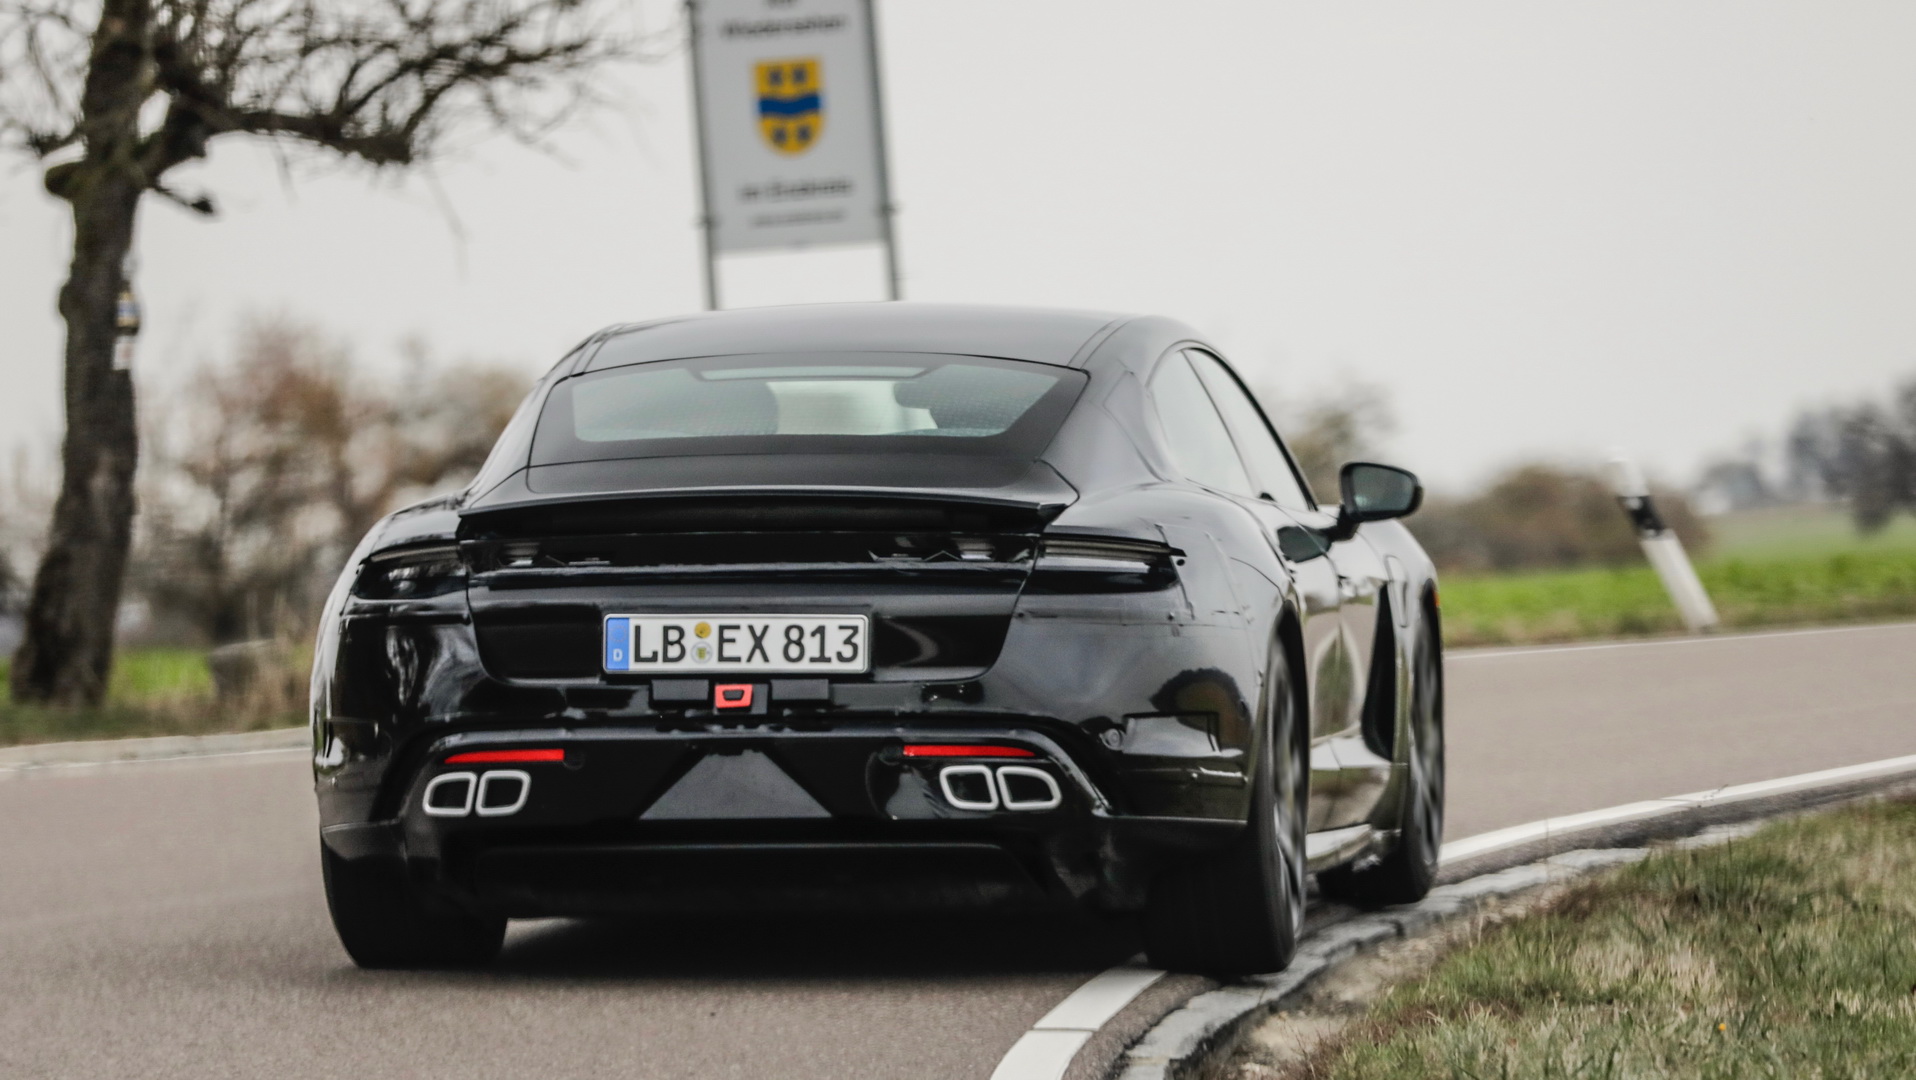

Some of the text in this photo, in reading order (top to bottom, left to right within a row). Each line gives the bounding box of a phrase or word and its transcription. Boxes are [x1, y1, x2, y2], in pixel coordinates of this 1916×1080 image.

[612, 648, 623, 662] D
[633, 624, 860, 663] LB EX 813
